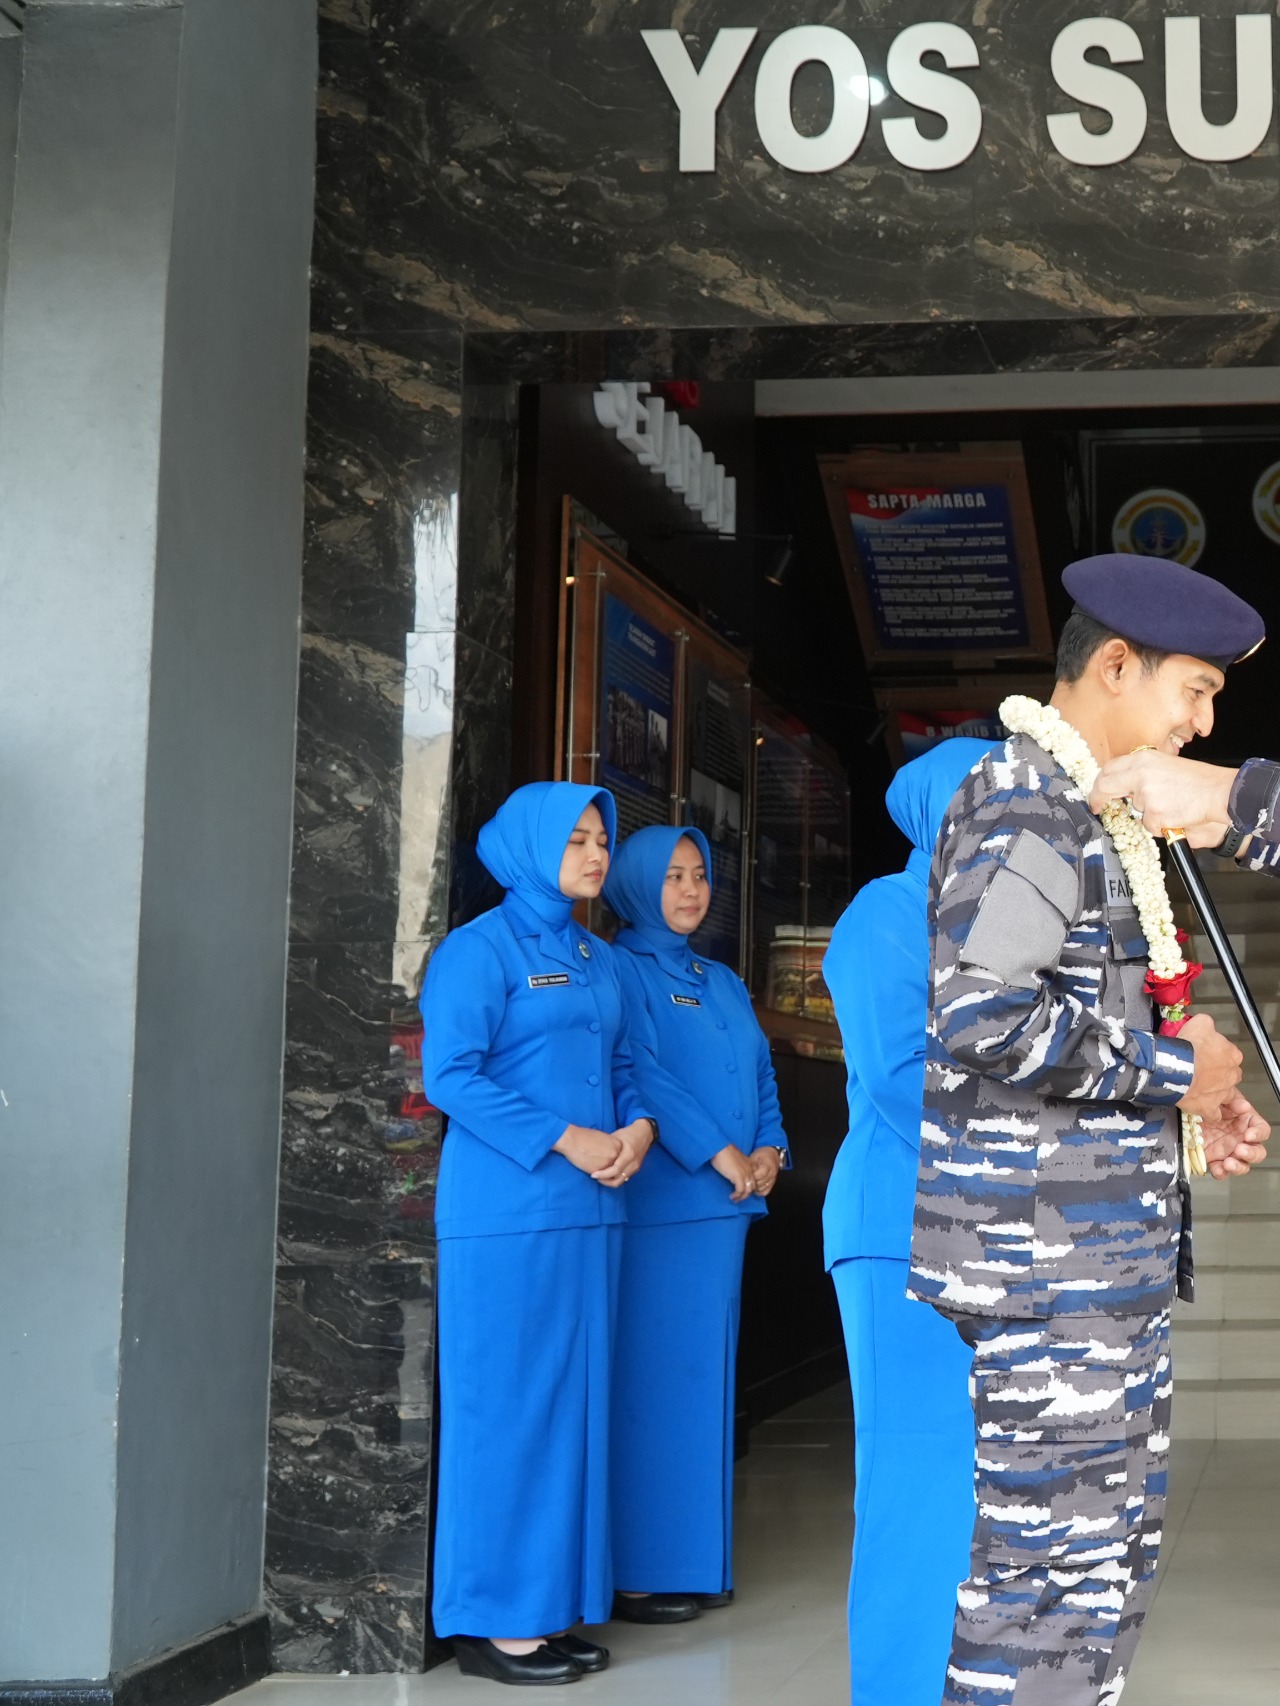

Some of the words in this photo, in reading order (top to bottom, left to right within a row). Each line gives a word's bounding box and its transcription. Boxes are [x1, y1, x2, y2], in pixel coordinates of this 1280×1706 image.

[641, 22, 982, 173] YOS
[867, 493, 921, 509] SAPTA
[925, 492, 987, 509] MARGA
[941, 726, 990, 738] WAJIB
